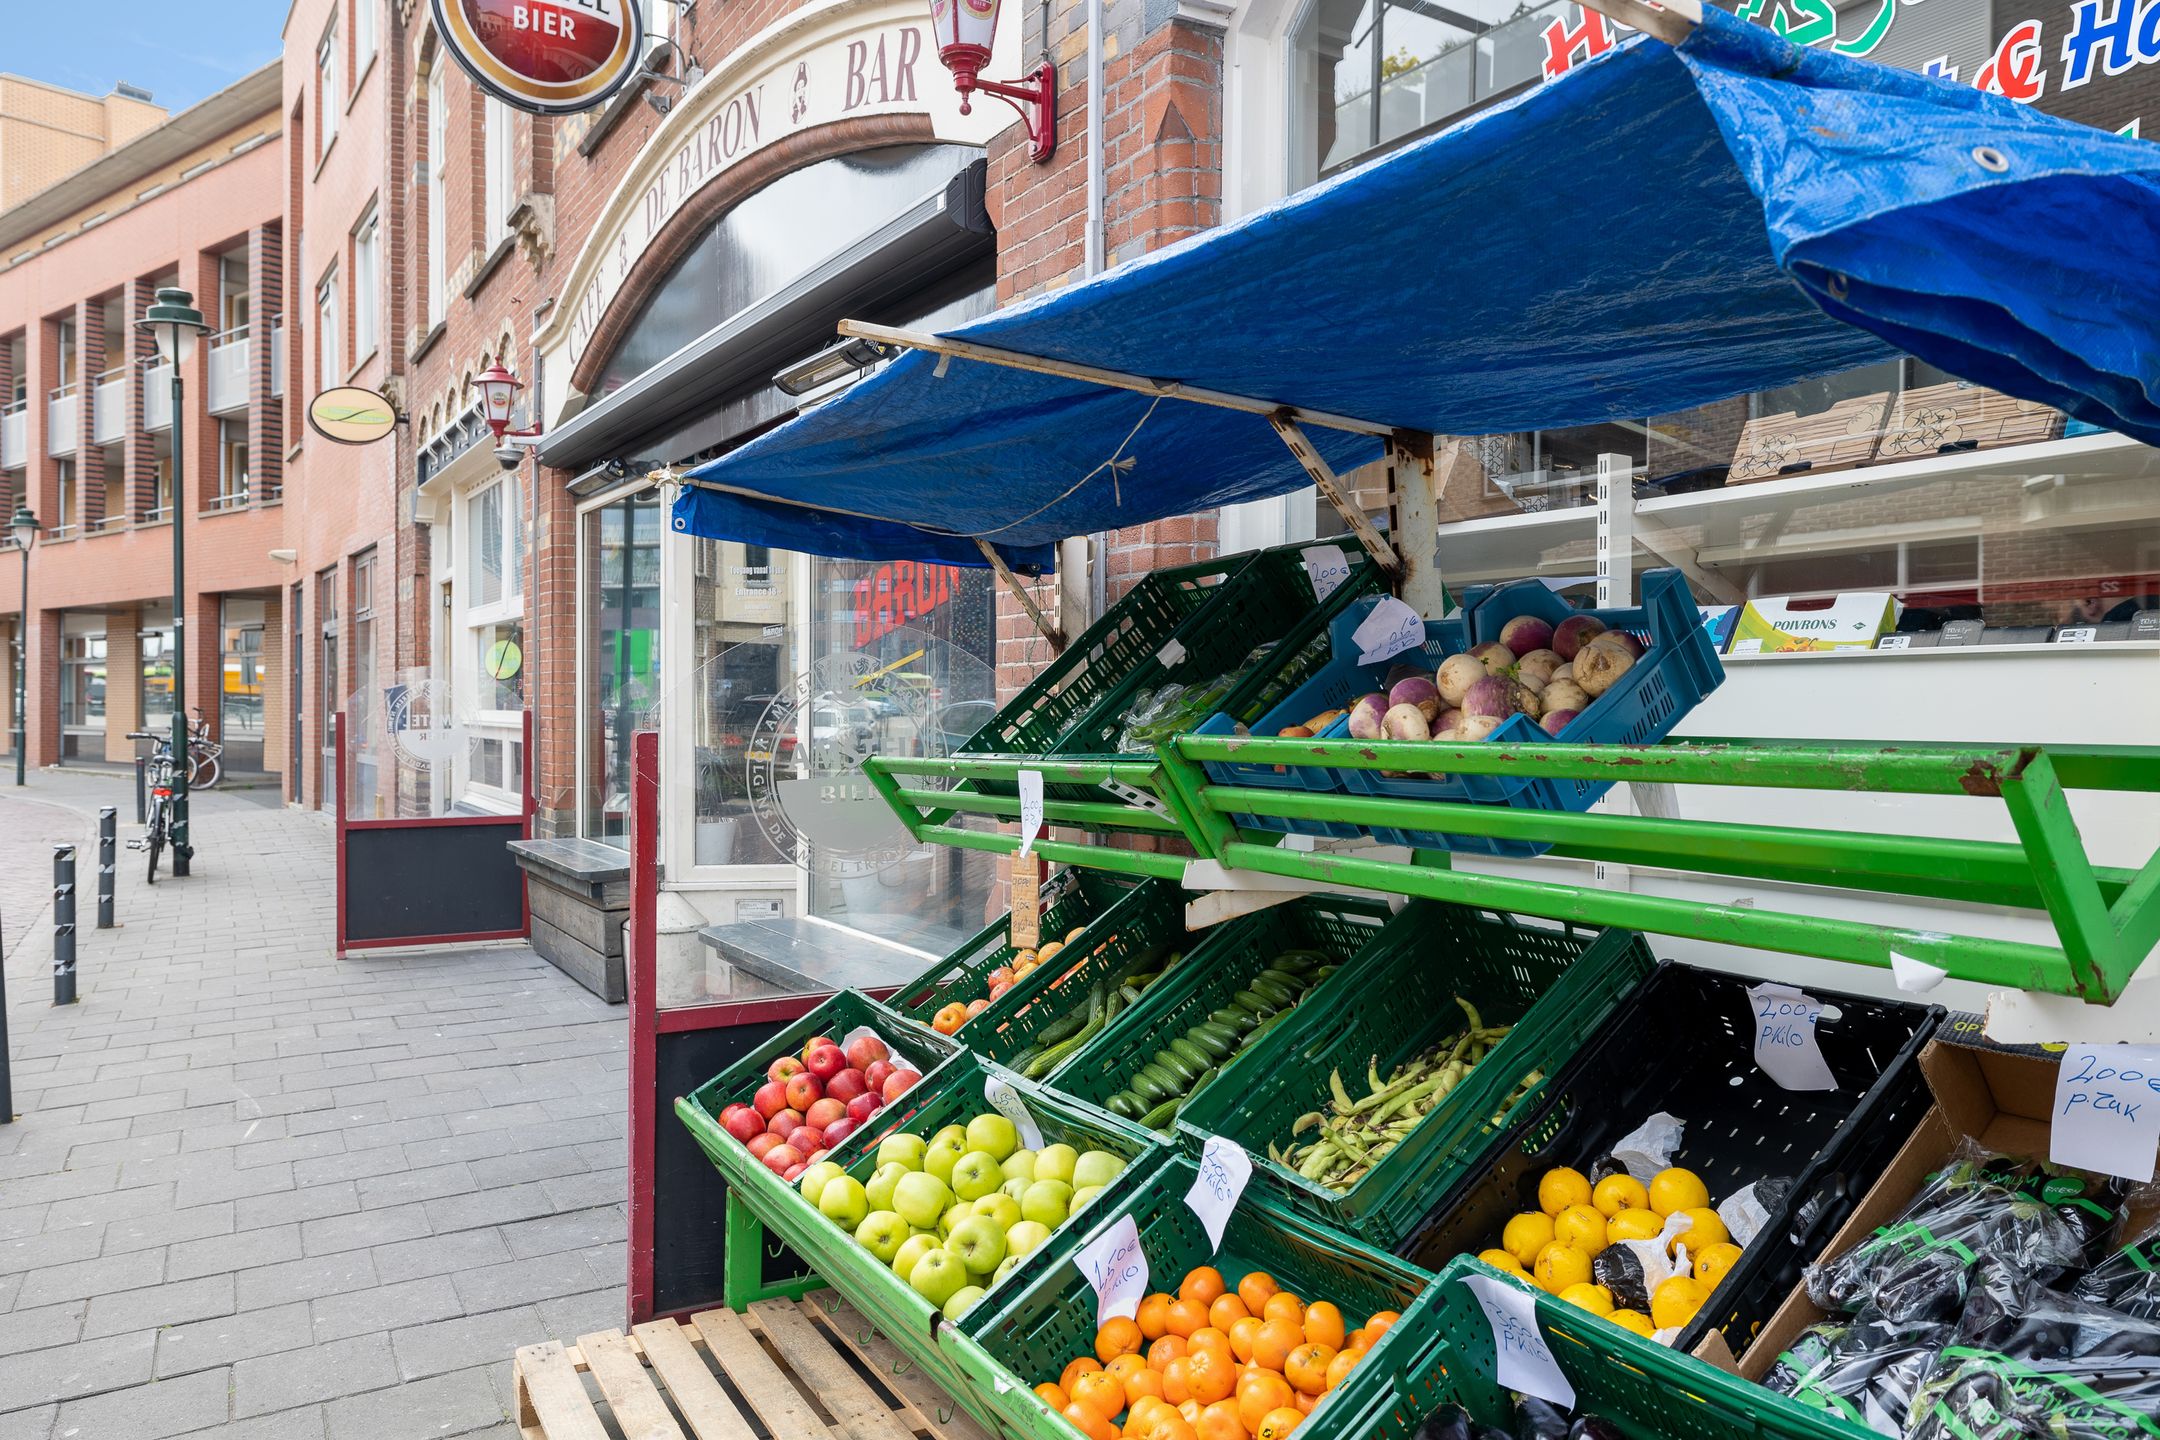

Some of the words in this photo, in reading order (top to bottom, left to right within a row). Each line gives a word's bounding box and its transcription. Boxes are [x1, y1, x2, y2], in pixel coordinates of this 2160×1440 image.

[513, 5, 576, 41] BIER
[645, 166, 671, 241] DE
[677, 84, 765, 201] BARON
[842, 27, 921, 112] BAR
[735, 588, 767, 597] Entrance
[1772, 618, 1838, 631] POIVRONS
[768, 822, 788, 843] DE
